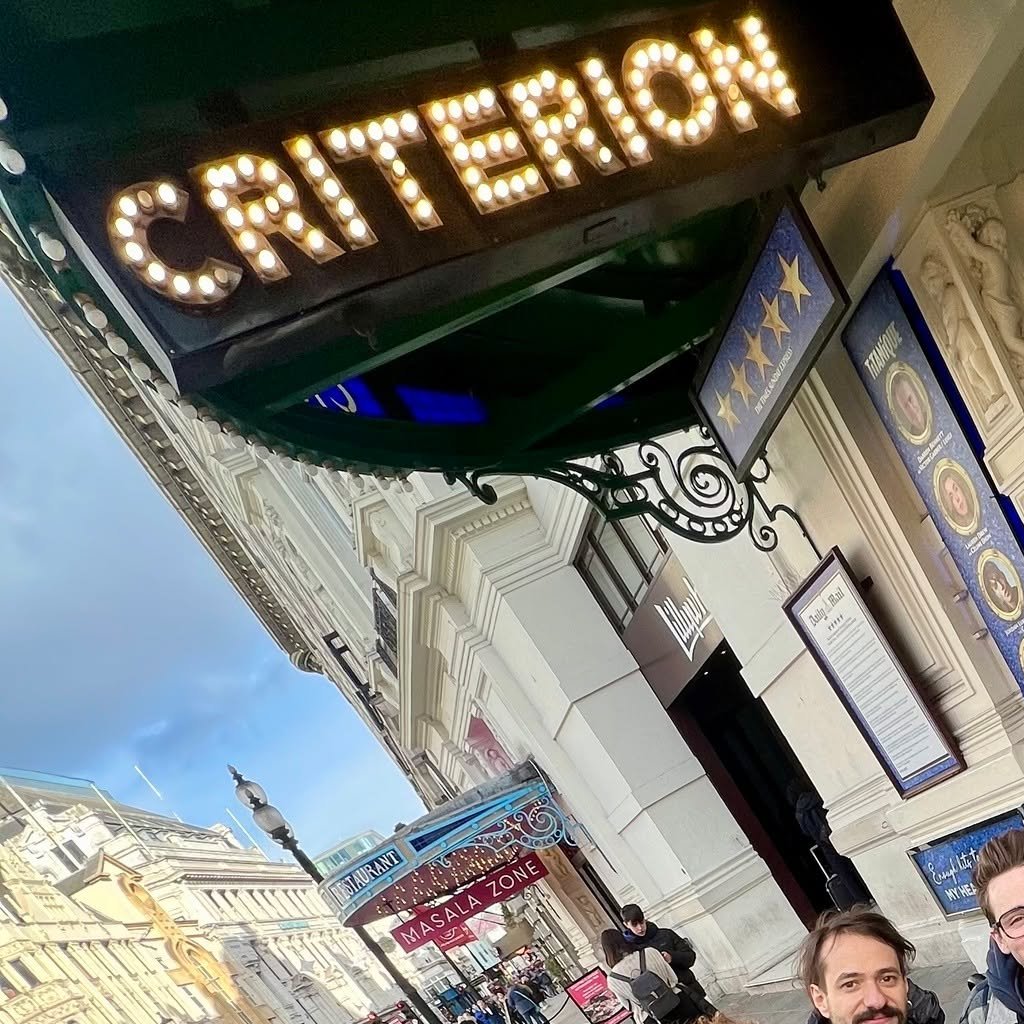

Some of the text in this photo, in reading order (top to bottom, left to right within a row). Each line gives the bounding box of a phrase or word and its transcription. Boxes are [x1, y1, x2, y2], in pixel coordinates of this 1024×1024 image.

[107, 16, 801, 303] CRITERION
[828, 586, 845, 607] Mail
[332, 850, 401, 901] RESTAURANT
[945, 883, 977, 901] MY HEA
[400, 860, 540, 945] MASALA ZONE
